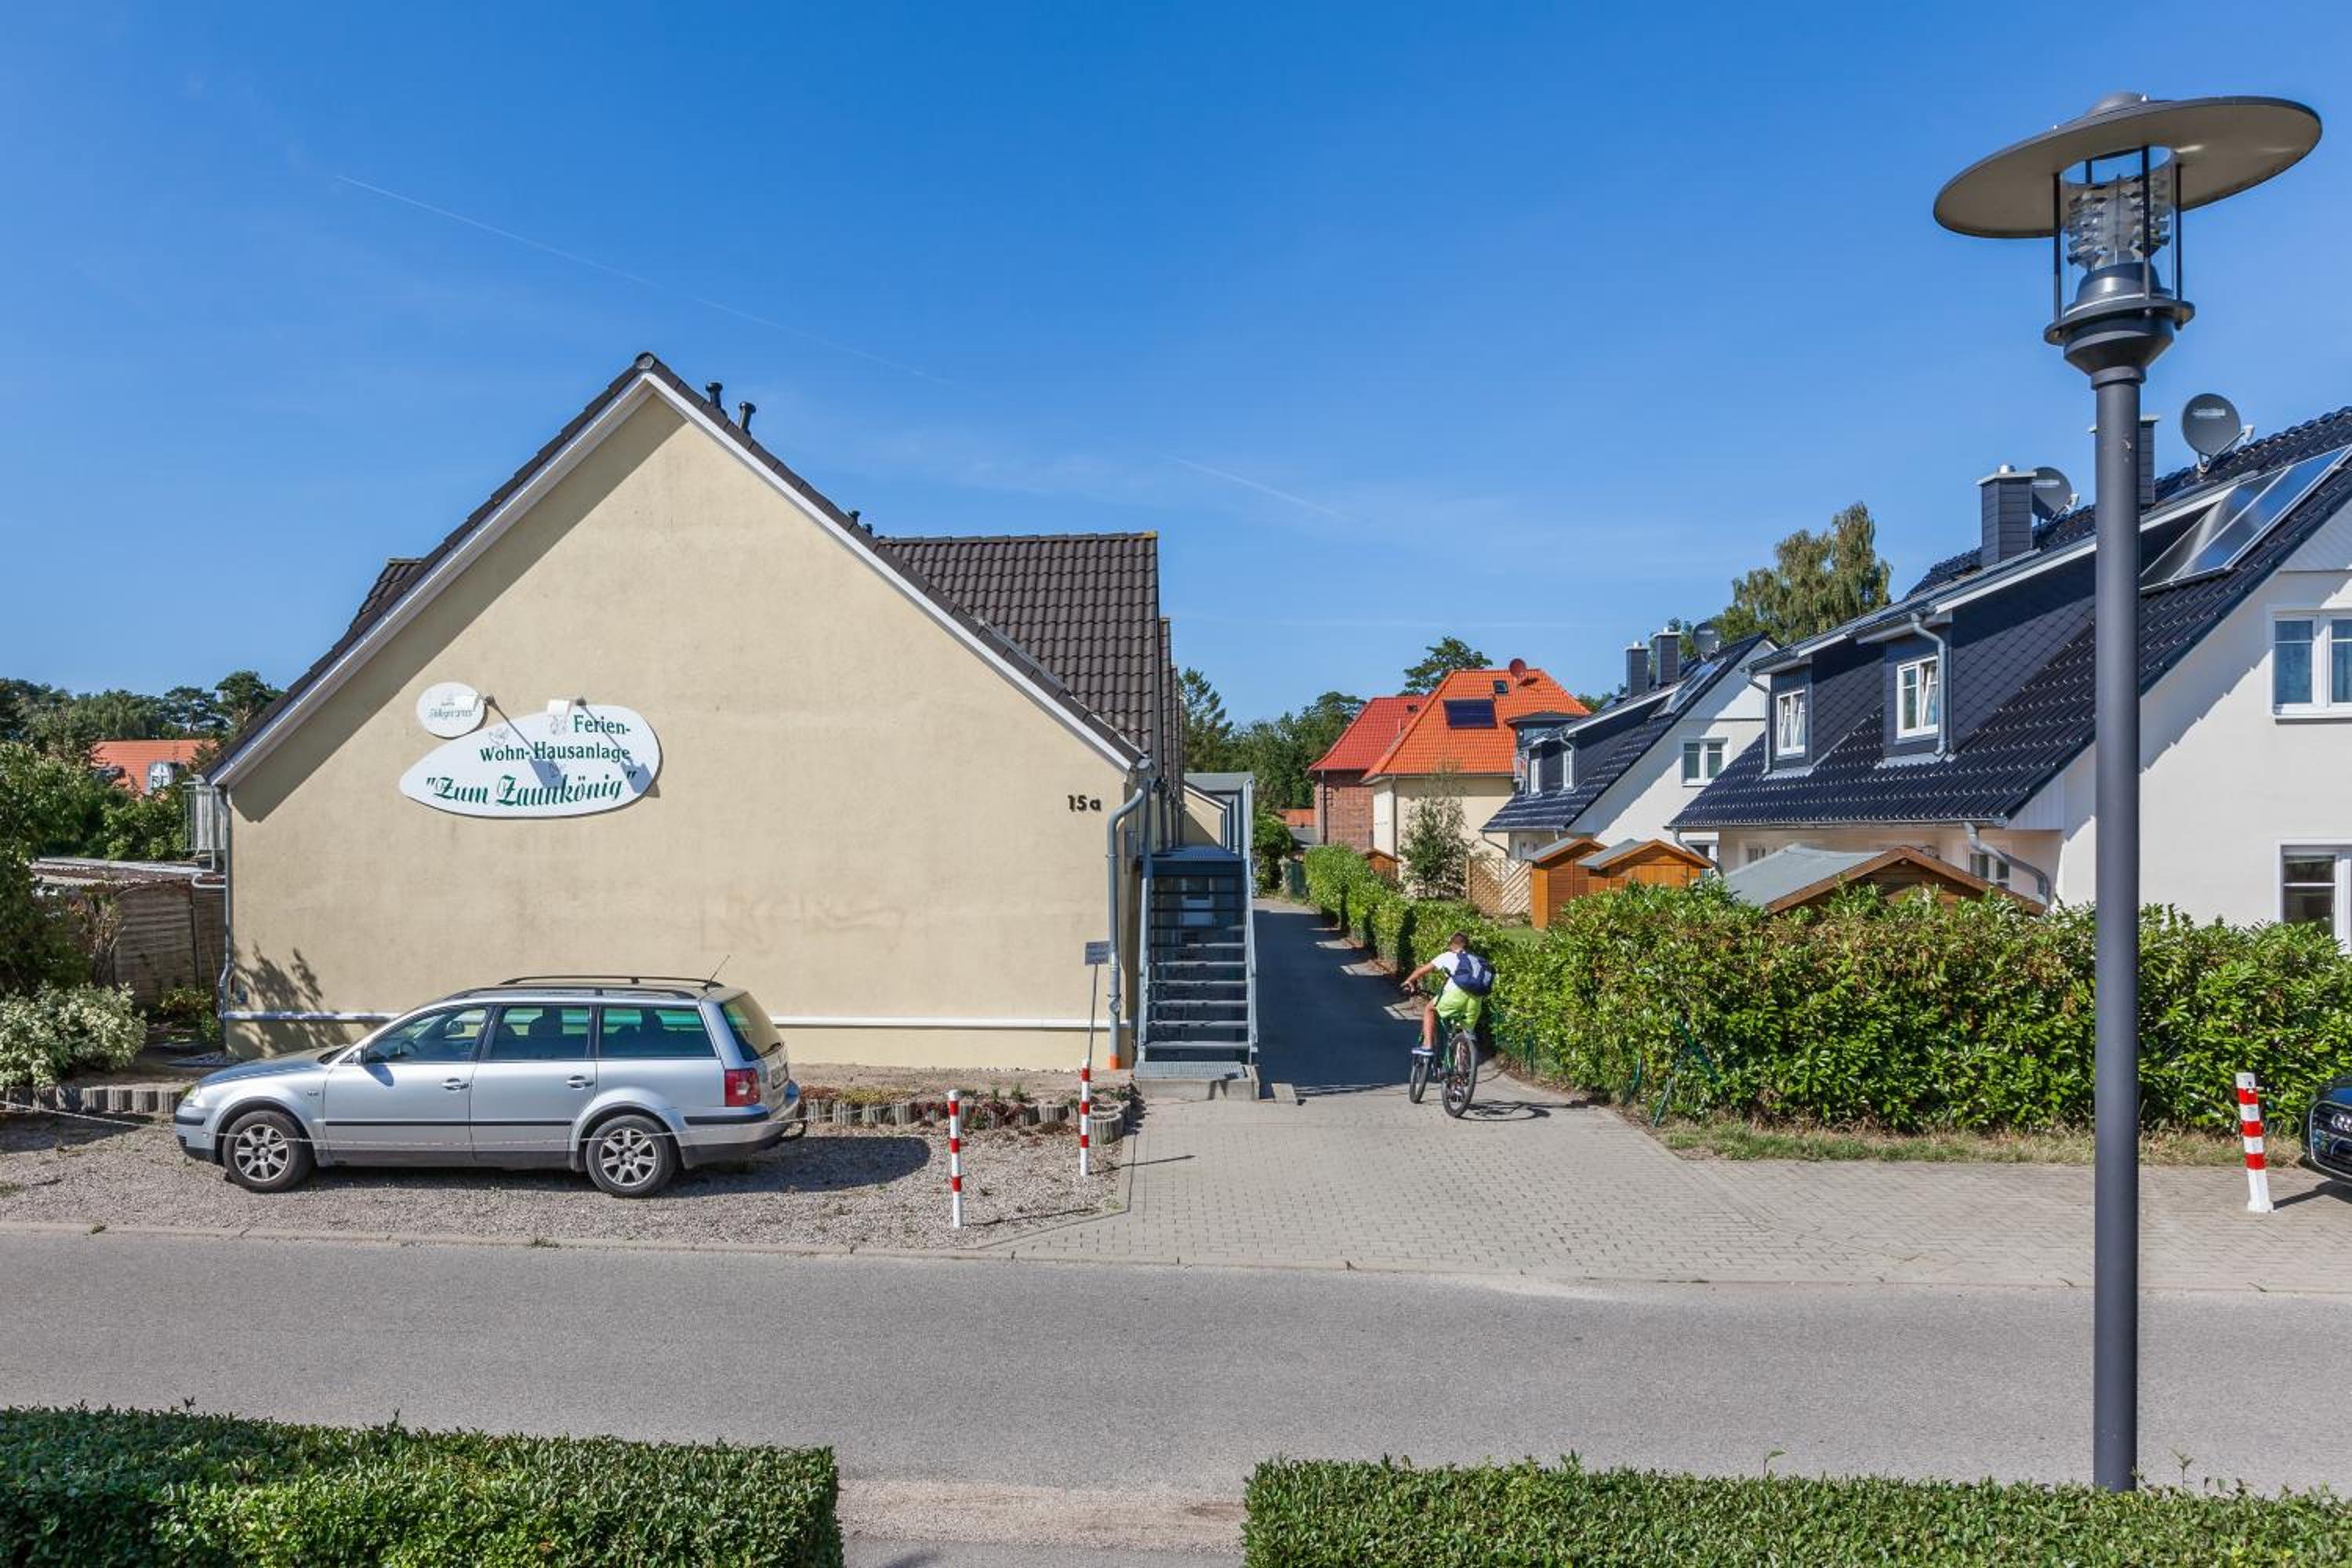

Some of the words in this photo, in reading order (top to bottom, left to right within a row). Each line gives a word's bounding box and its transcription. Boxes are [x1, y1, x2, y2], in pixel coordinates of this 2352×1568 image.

[573, 714, 630, 735] Ferien-
[426, 776, 489, 805] "Zum
[1067, 794, 1102, 812] 15a
